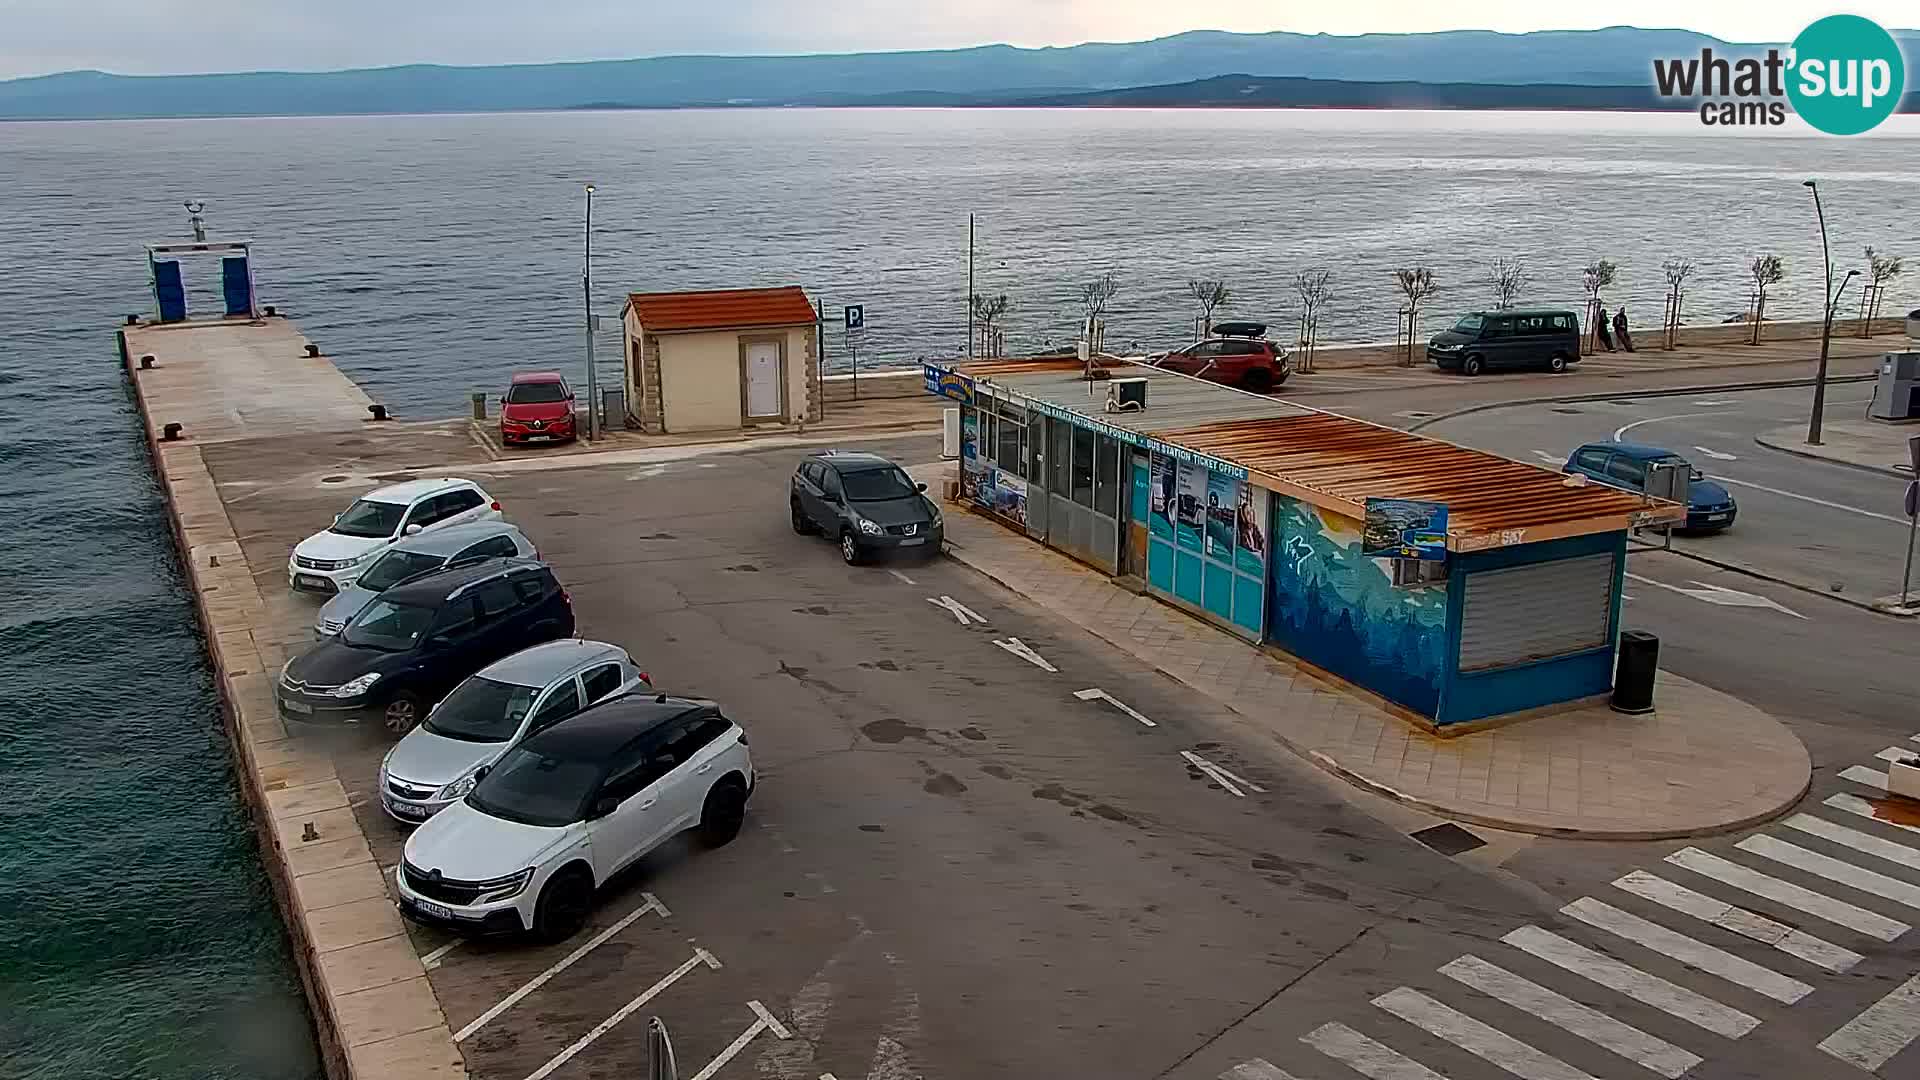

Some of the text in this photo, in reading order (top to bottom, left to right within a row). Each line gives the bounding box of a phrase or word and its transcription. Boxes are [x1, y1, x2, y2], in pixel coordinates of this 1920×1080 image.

[849, 308, 859, 325] P
[1072, 415, 1108, 434] AUTOBUSKA
[1109, 428, 1137, 443] POSTAJA
[1147, 439, 1160, 451] BUS
[1162, 446, 1190, 461] STATION
[1193, 454, 1218, 470] TICKET
[1219, 463, 1244, 478] OFFICE
